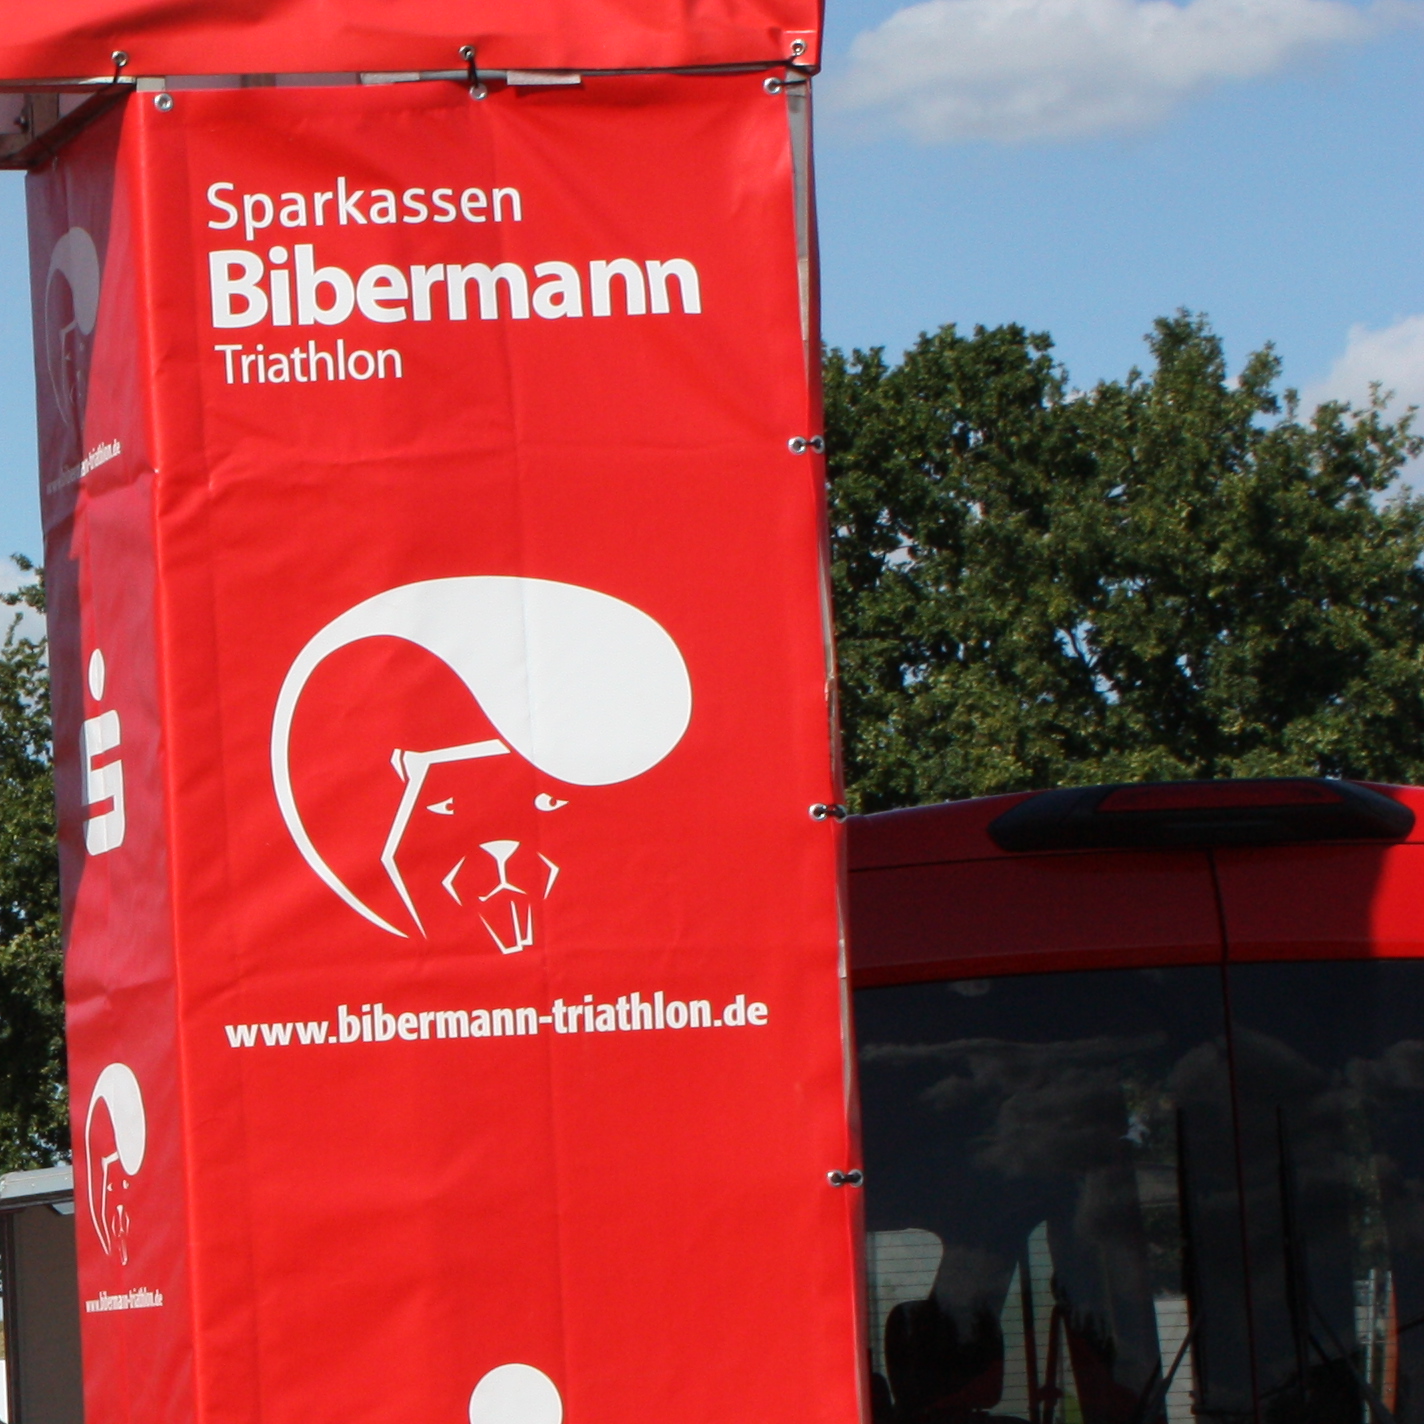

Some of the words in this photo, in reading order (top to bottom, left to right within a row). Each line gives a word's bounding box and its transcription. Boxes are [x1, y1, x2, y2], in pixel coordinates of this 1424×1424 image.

[206, 176, 523, 241] Sparkassen
[208, 244, 702, 329] Bibermann
[214, 339, 403, 384] Triathlon
[225, 991, 769, 1048] www.bibermann-triathlon.de
